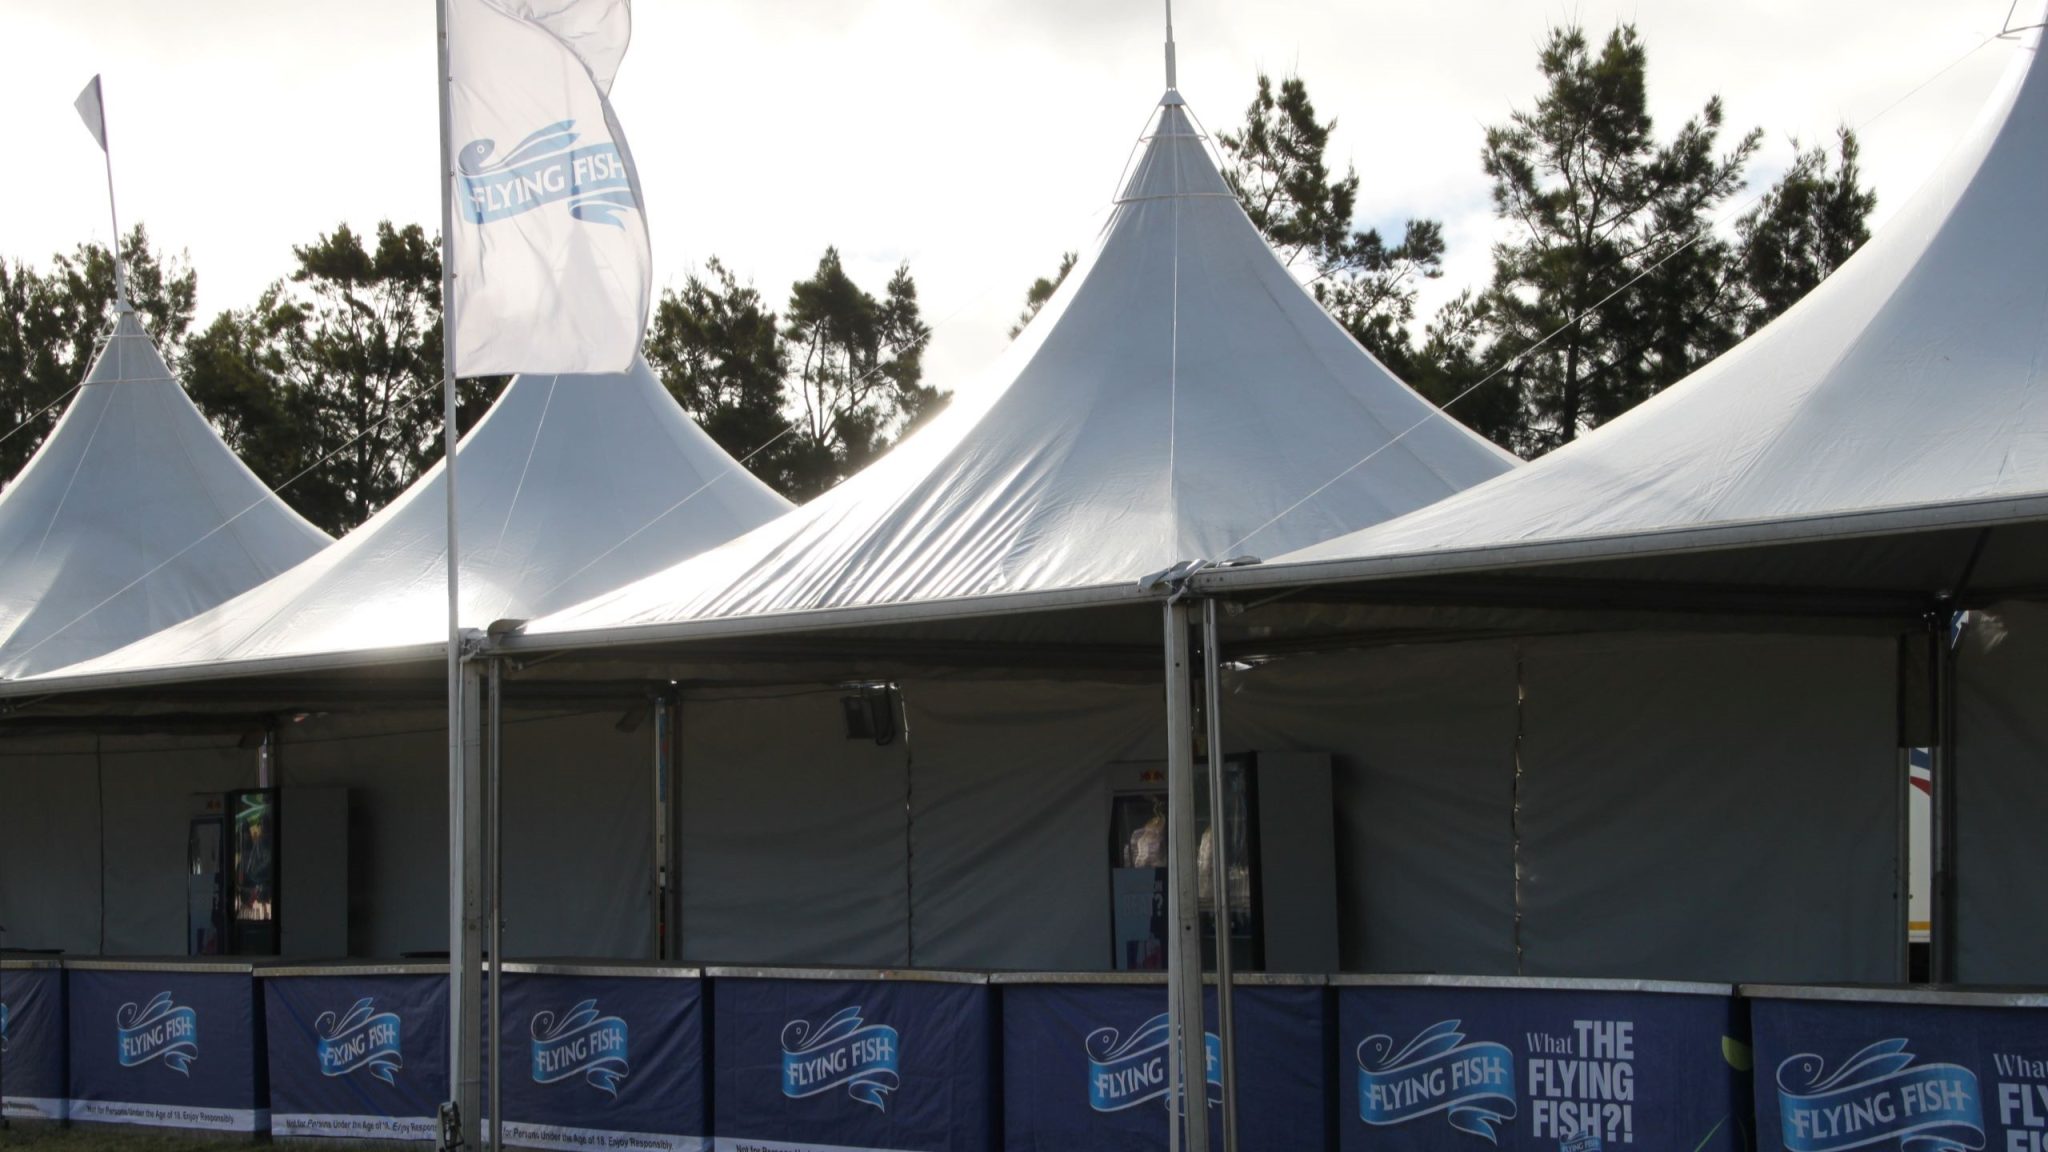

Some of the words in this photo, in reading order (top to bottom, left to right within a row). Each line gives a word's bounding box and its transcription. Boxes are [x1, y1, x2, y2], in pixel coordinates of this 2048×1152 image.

[469, 165, 565, 213] FLYING
[573, 153, 628, 186] FISH
[122, 1026, 164, 1056] FLYING
[166, 1015, 194, 1041] FISH
[320, 1034, 365, 1066] FLYING
[369, 1023, 396, 1050] FISH
[535, 1037, 587, 1073] FLYING
[590, 1027, 624, 1053] FISH
[1526, 1032, 1573, 1054] What
[1573, 1020, 1634, 1060] THE
[787, 1047, 847, 1085] FLYING
[852, 1036, 895, 1064] FISH
[1094, 1057, 1164, 1099] FLYING
[1529, 1059, 1634, 1101] FLYING
[1993, 1053, 2048, 1078] Wha
[1365, 1068, 1446, 1111] FLYING
[1451, 1057, 1507, 1090] FISH
[146, 1109, 154, 1118] the
[155, 1109, 166, 1120] Age
[167, 1110, 173, 1119] of
[183, 1111, 199, 1123] Enjoy
[333, 1120, 351, 1129] Under
[363, 1120, 374, 1131] Age
[375, 1121, 382, 1130] of
[1533, 1100, 1633, 1143] FISH?!
[1790, 1092, 1896, 1139] FLYING
[1900, 1080, 1971, 1116] FISH
[503, 1127, 512, 1137] for
[513, 1128, 540, 1140] Persons
[540, 1131, 561, 1141] Under
[561, 1132, 573, 1142] the
[573, 1133, 588, 1145] Age
[588, 1133, 595, 1144] of
[608, 1136, 628, 1148] Enjoy
